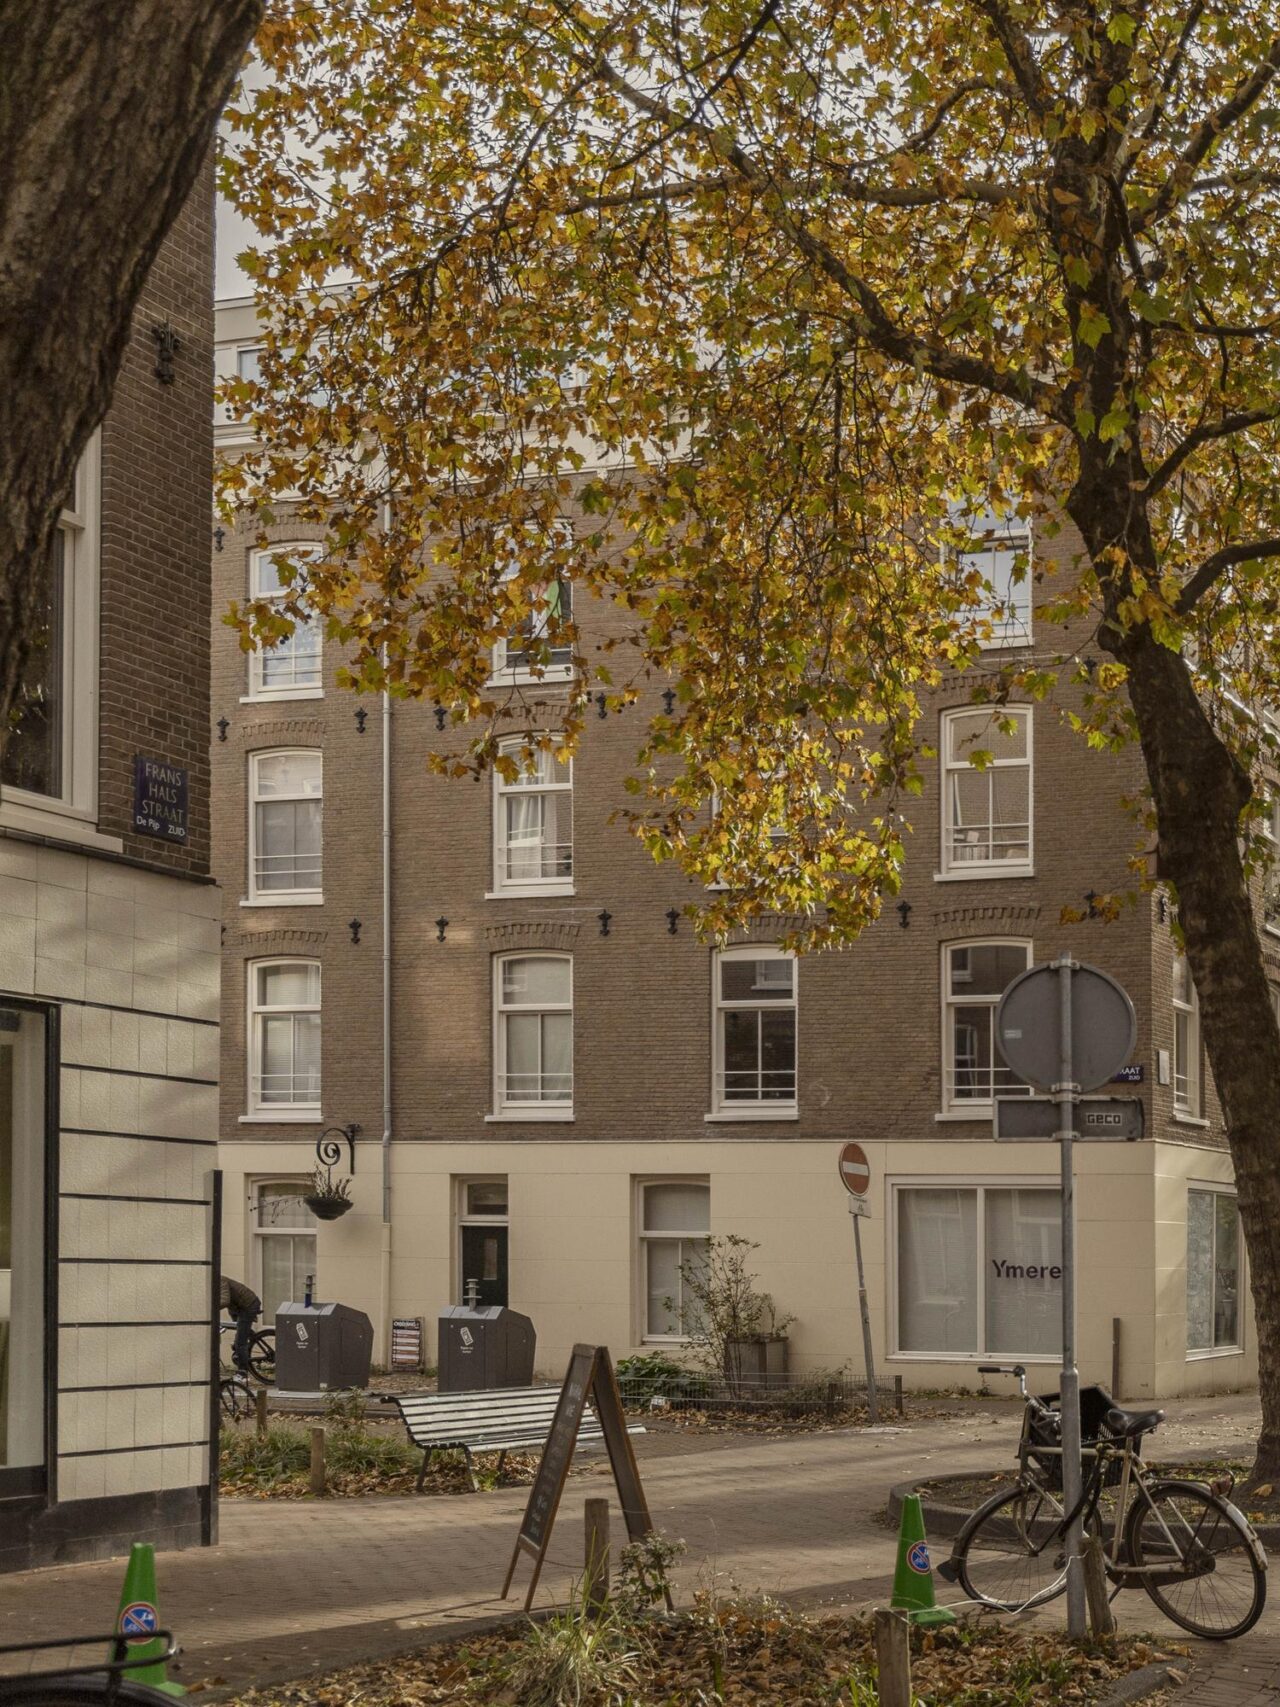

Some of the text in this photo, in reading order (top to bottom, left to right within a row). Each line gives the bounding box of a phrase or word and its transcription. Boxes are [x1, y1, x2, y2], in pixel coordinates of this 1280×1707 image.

[145, 762, 182, 787] FRANS
[148, 783, 177, 804] HALS
[142, 800, 184, 824] STRAAT
[136, 815, 147, 826] De
[168, 824, 186, 837] ZUID
[992, 1259, 1062, 1279] Ymere
